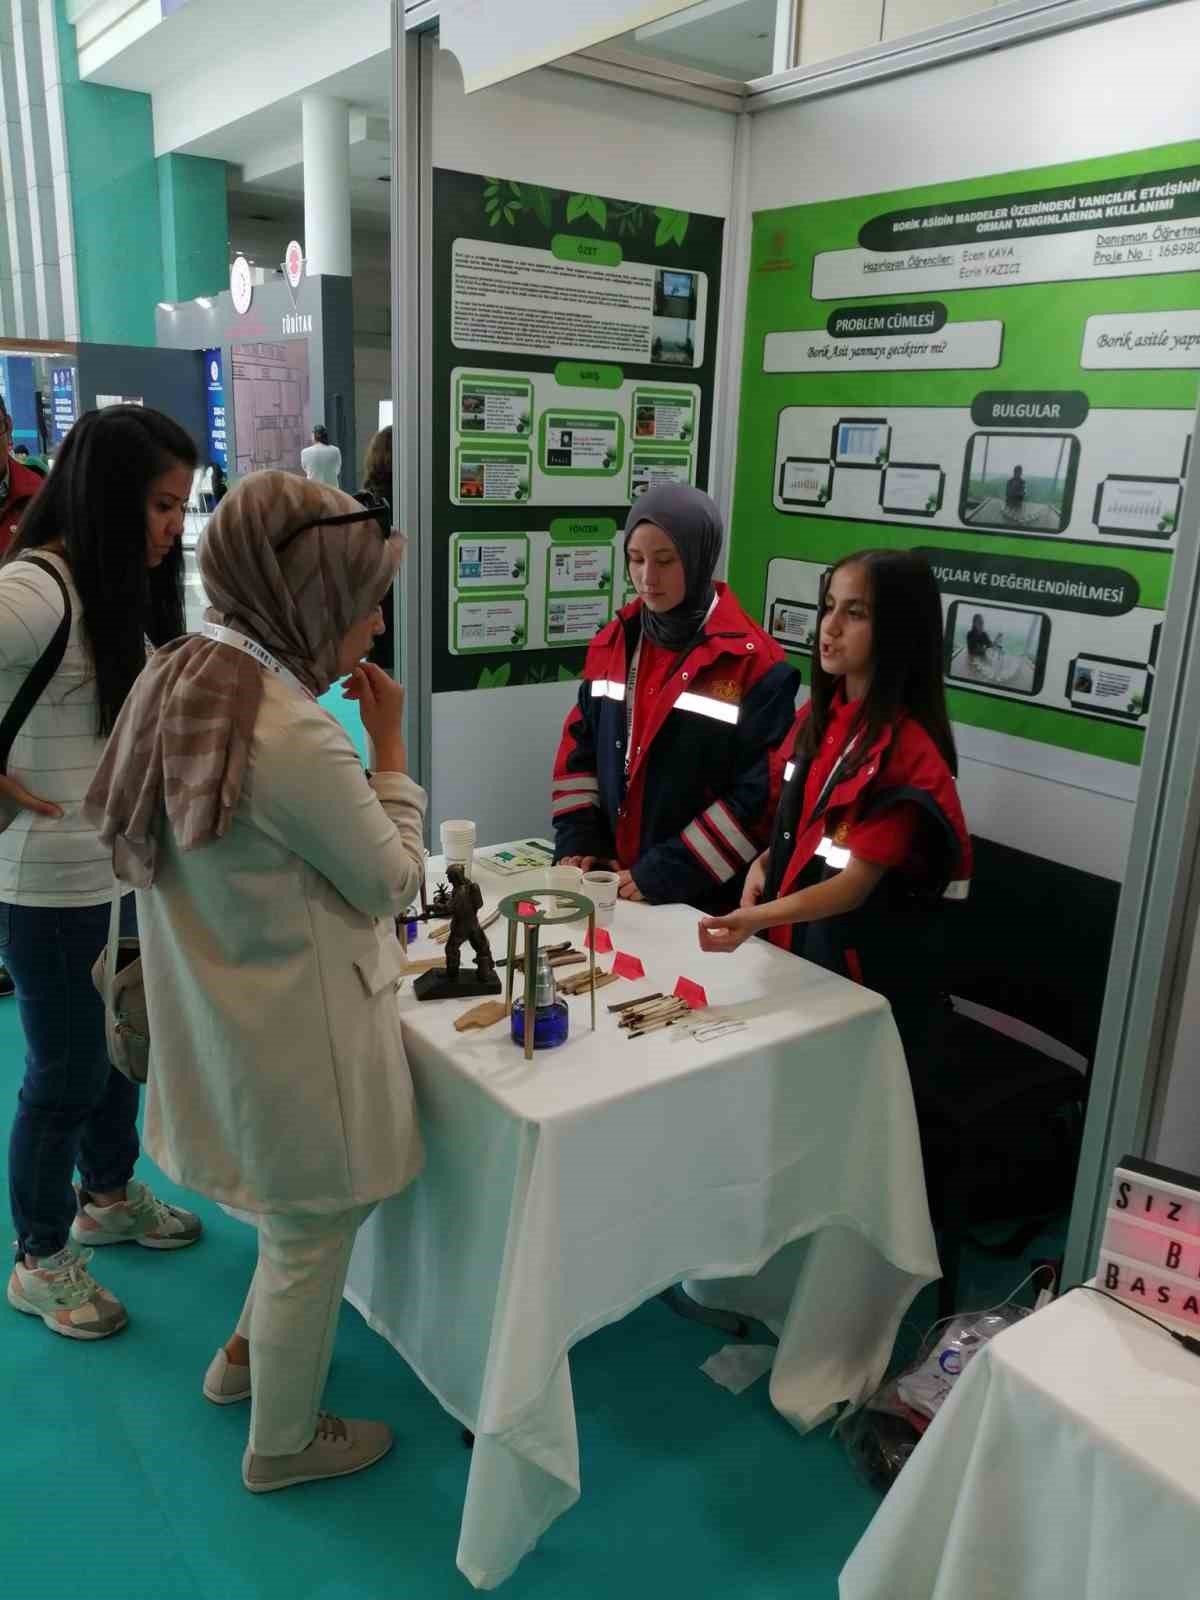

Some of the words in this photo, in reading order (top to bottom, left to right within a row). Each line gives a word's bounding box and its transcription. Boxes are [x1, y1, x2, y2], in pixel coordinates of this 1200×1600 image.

[1078, 190, 1137, 207] YANICILIK
[1105, 199, 1175, 217] KULLANIMI
[835, 318, 884, 332] PROBLEM
[886, 311, 935, 328] CÜMLESİ
[1097, 330, 1133, 350] Borik
[992, 403, 1060, 420] BULGULAR
[973, 571, 988, 585] VE
[990, 573, 1125, 603] DEĞERLENDİRİLMESİ
